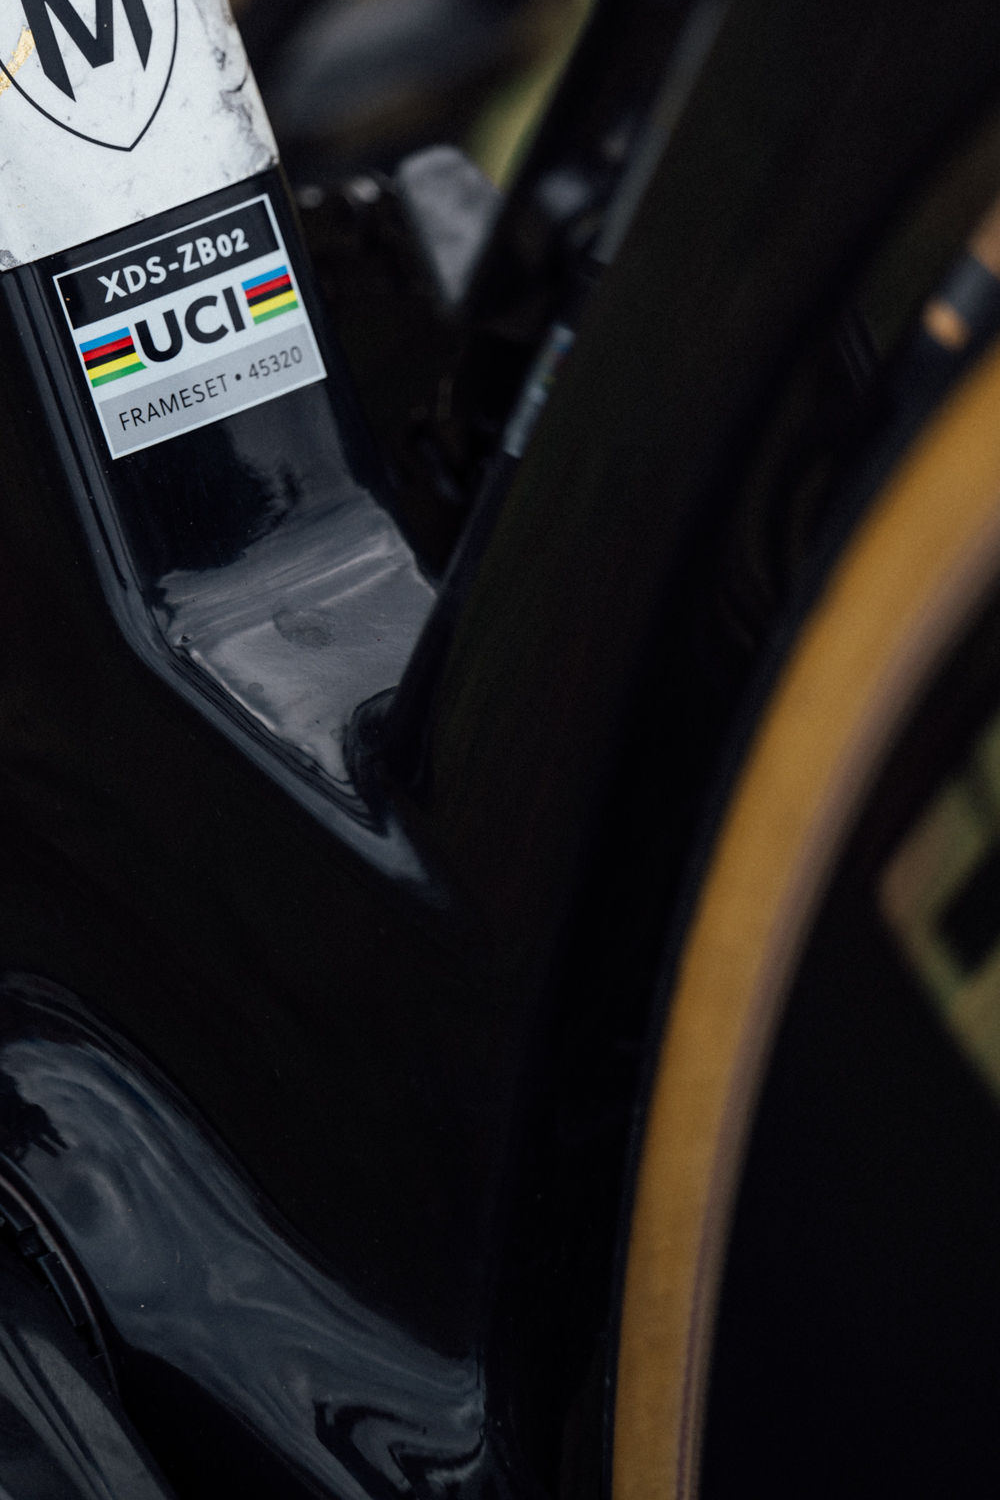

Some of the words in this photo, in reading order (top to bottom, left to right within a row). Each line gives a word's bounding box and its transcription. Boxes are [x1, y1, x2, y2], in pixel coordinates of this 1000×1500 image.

[98, 228, 249, 303] XDS-ZB02
[134, 286, 246, 363] UCI
[119, 373, 228, 431] FRAMESET
[249, 345, 303, 380] 45320
